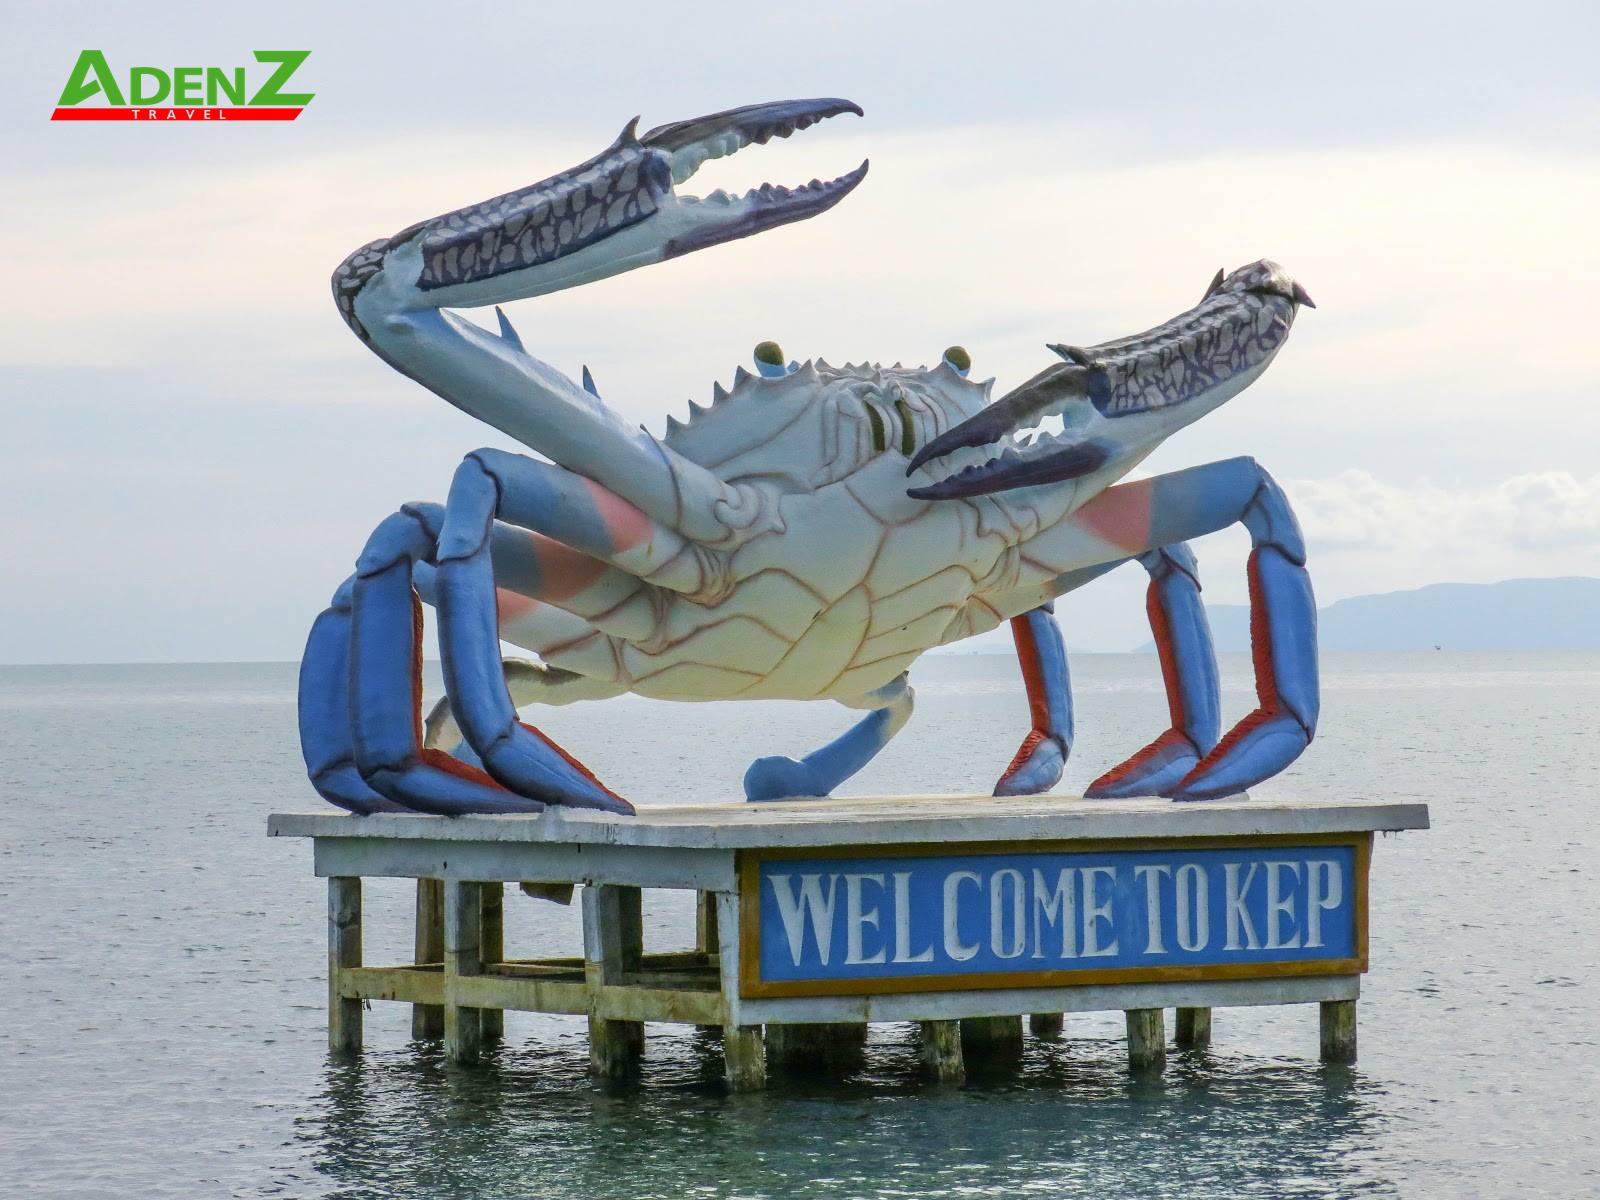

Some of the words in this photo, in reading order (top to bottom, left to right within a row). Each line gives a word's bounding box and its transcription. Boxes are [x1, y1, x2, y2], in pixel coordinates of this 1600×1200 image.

[766, 865, 1120, 968] WELCOME
[1134, 862, 1210, 955] TO
[1222, 859, 1344, 952] KEP
